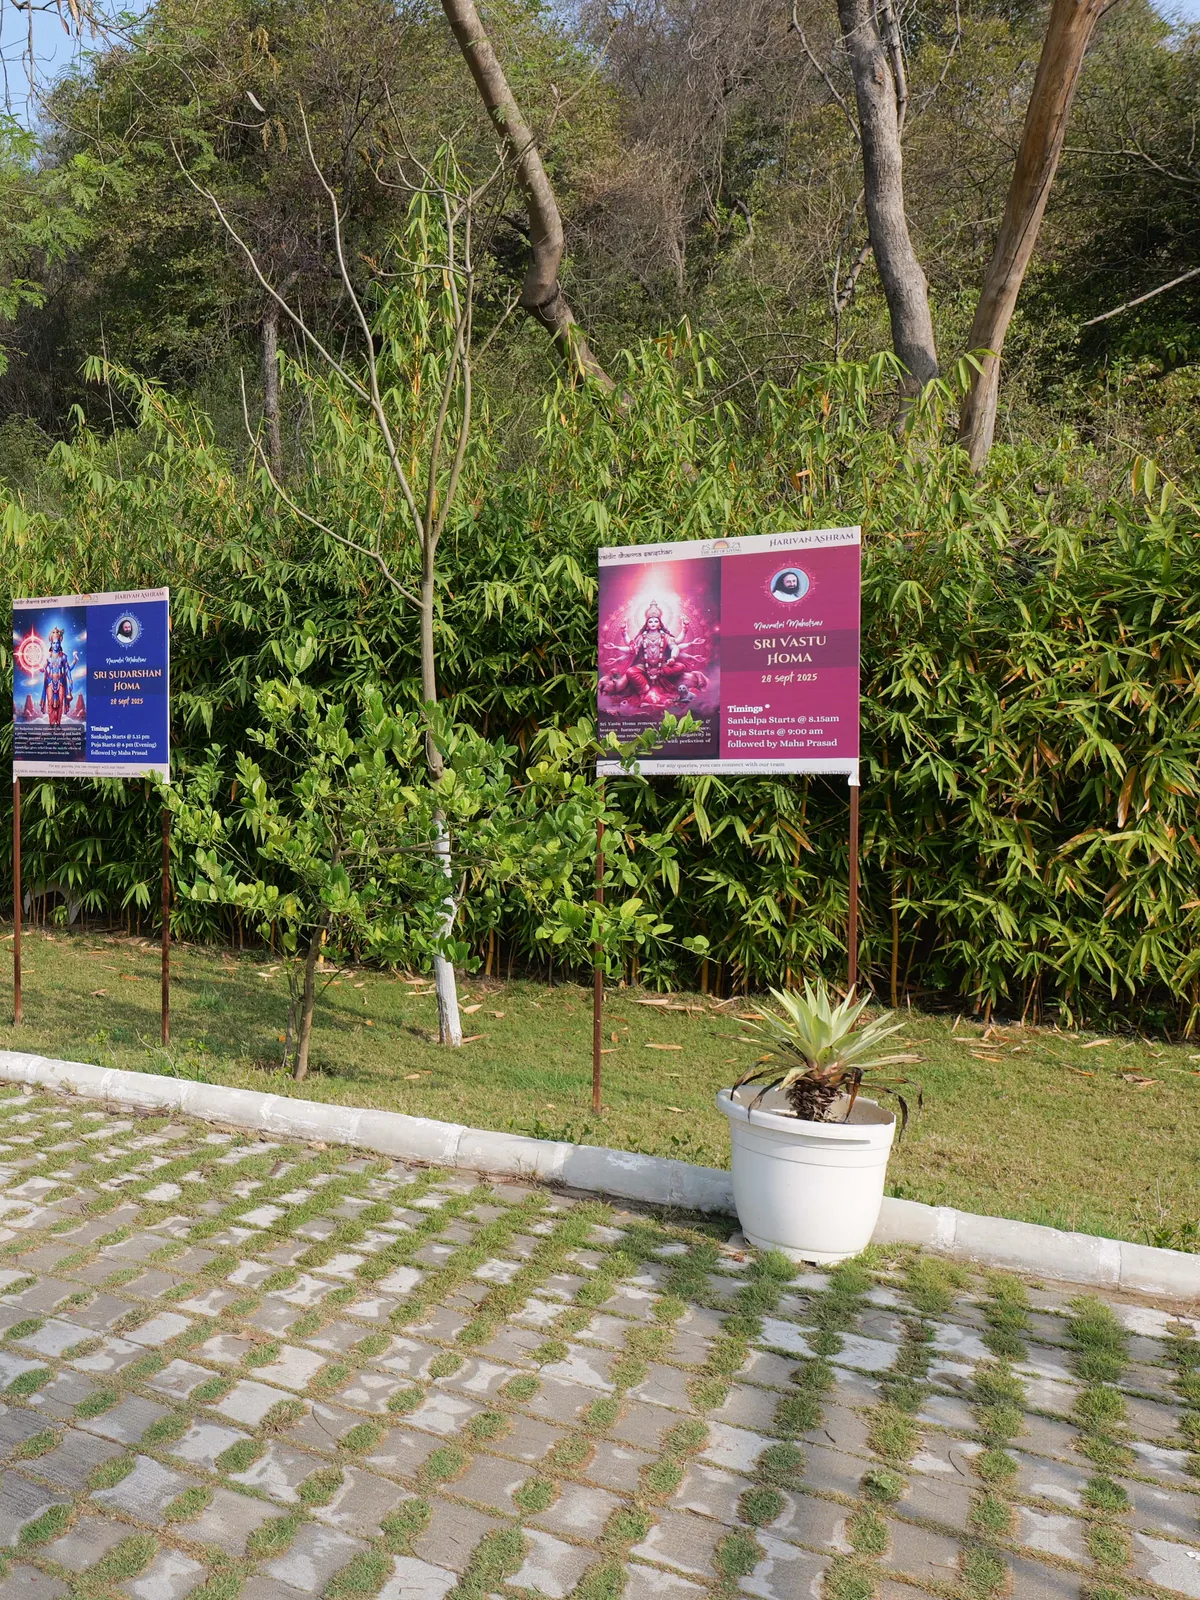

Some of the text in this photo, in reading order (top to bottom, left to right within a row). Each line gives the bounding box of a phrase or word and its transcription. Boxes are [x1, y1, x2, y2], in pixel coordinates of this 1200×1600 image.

[770, 533, 854, 547] HARIVAN ASHRAM
[754, 635, 827, 650] SRI VASTU
[767, 652, 812, 666] HOMA
[93, 669, 161, 679] SRI SUDARSHAN
[762, 671, 818, 686] 28 sept 2025
[114, 681, 140, 692] HOMA
[727, 705, 763, 714] Timings
[728, 716, 766, 725] Sankalpa
[728, 729, 746, 737] Puja
[767, 740, 777, 749] by
